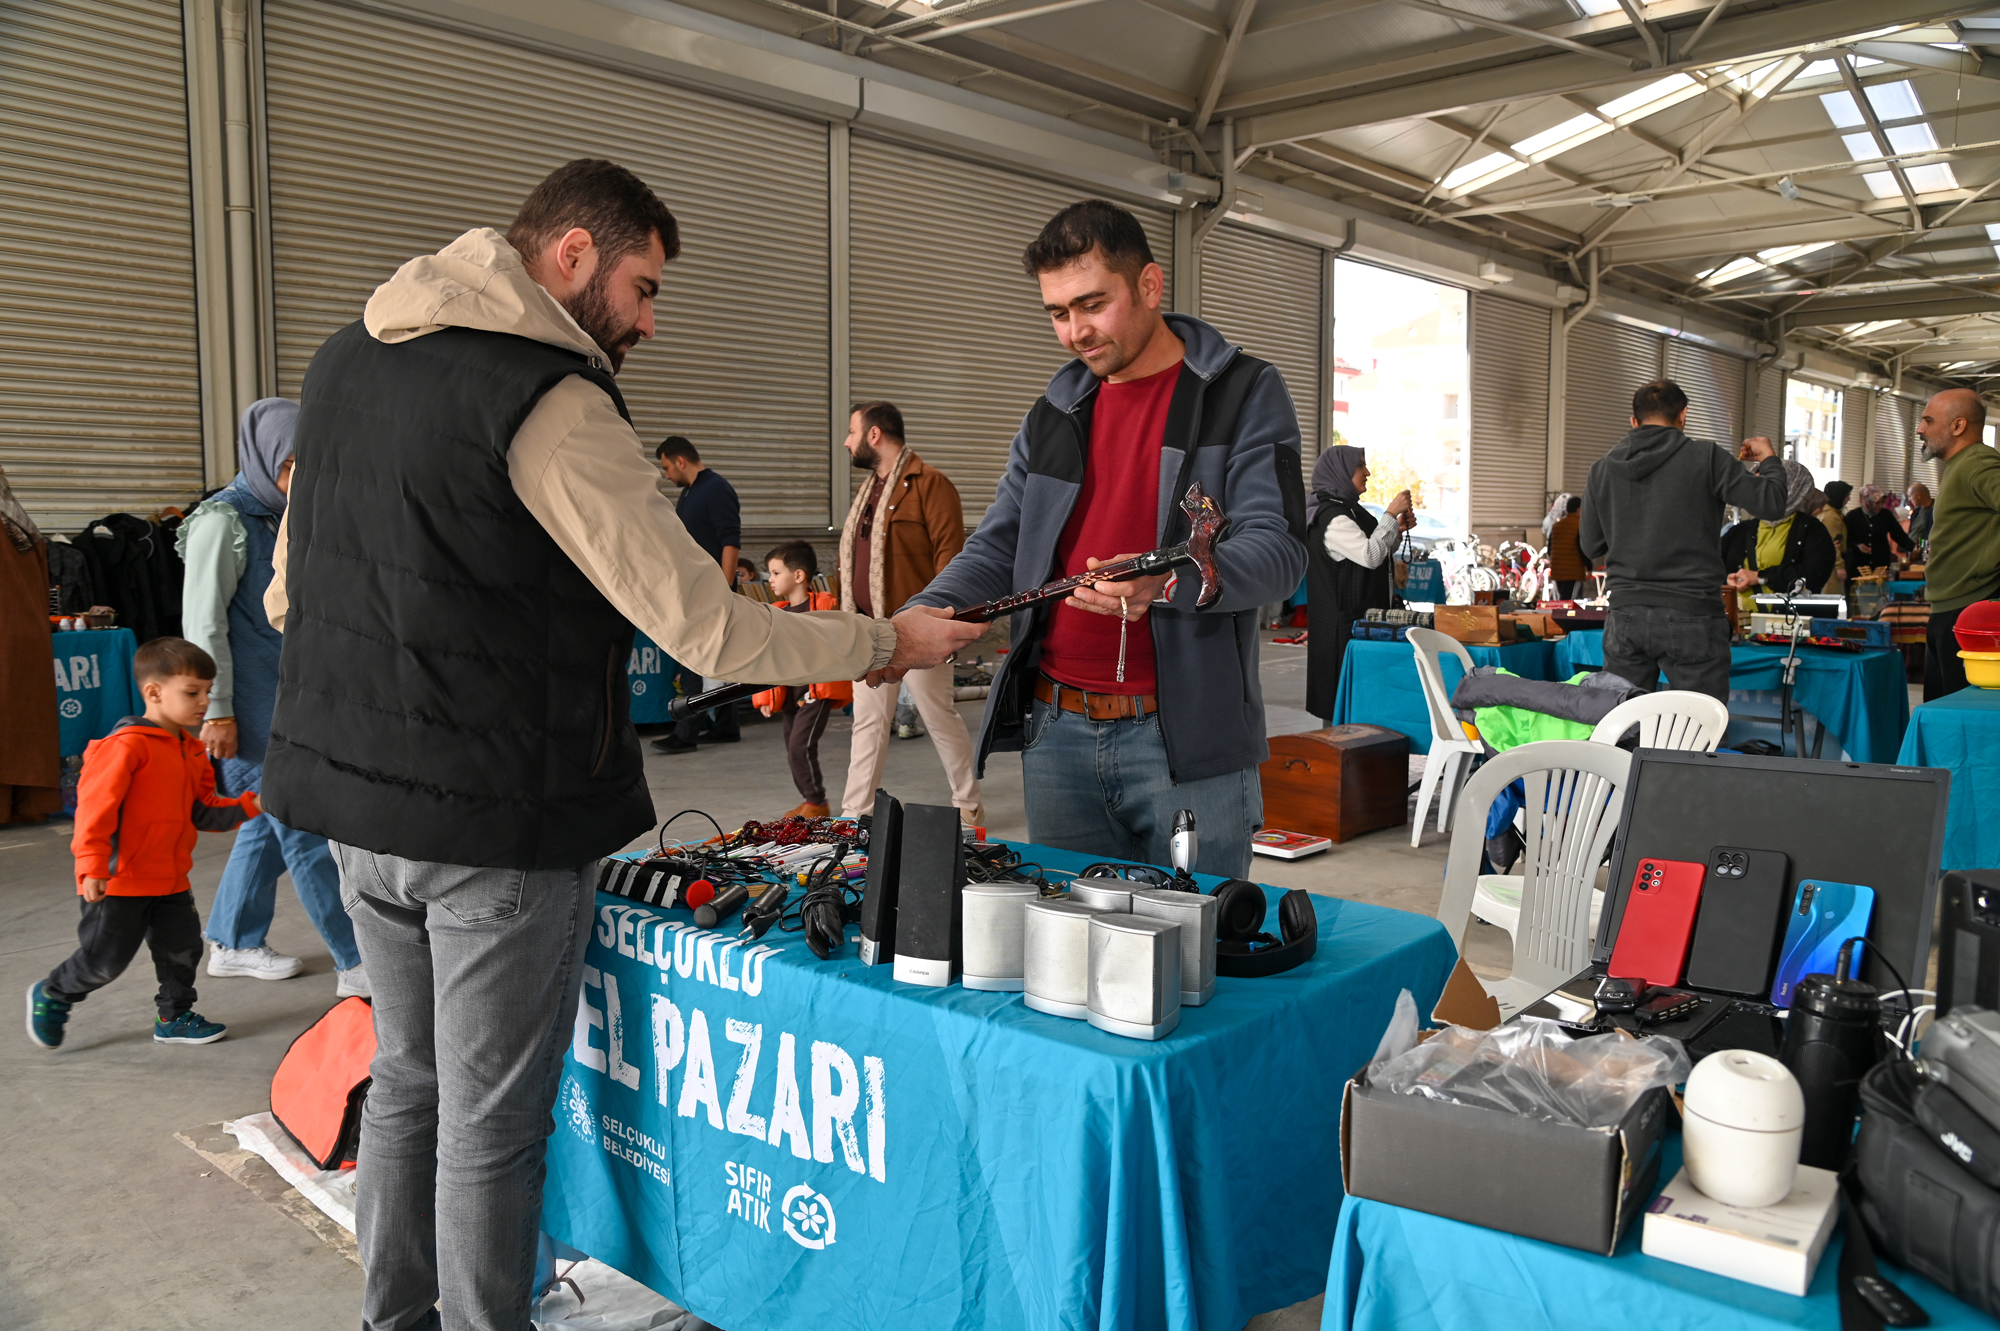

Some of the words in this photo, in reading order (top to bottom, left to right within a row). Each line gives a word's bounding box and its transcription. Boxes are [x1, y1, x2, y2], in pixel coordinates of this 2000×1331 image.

[596, 904, 785, 996] SELÇUKLU
[908, 968, 930, 976] CASPER
[1780, 982, 1789, 996] Redmi
[573, 963, 640, 1091] EL
[650, 992, 886, 1184] PAZARI
[602, 1114, 666, 1160] SELÇUKLU
[1940, 1131, 1973, 1163] JVC
[603, 1134, 671, 1187] BELEDİYESİ
[724, 1160, 772, 1204] SIFIR
[726, 1187, 771, 1234] ATIK
